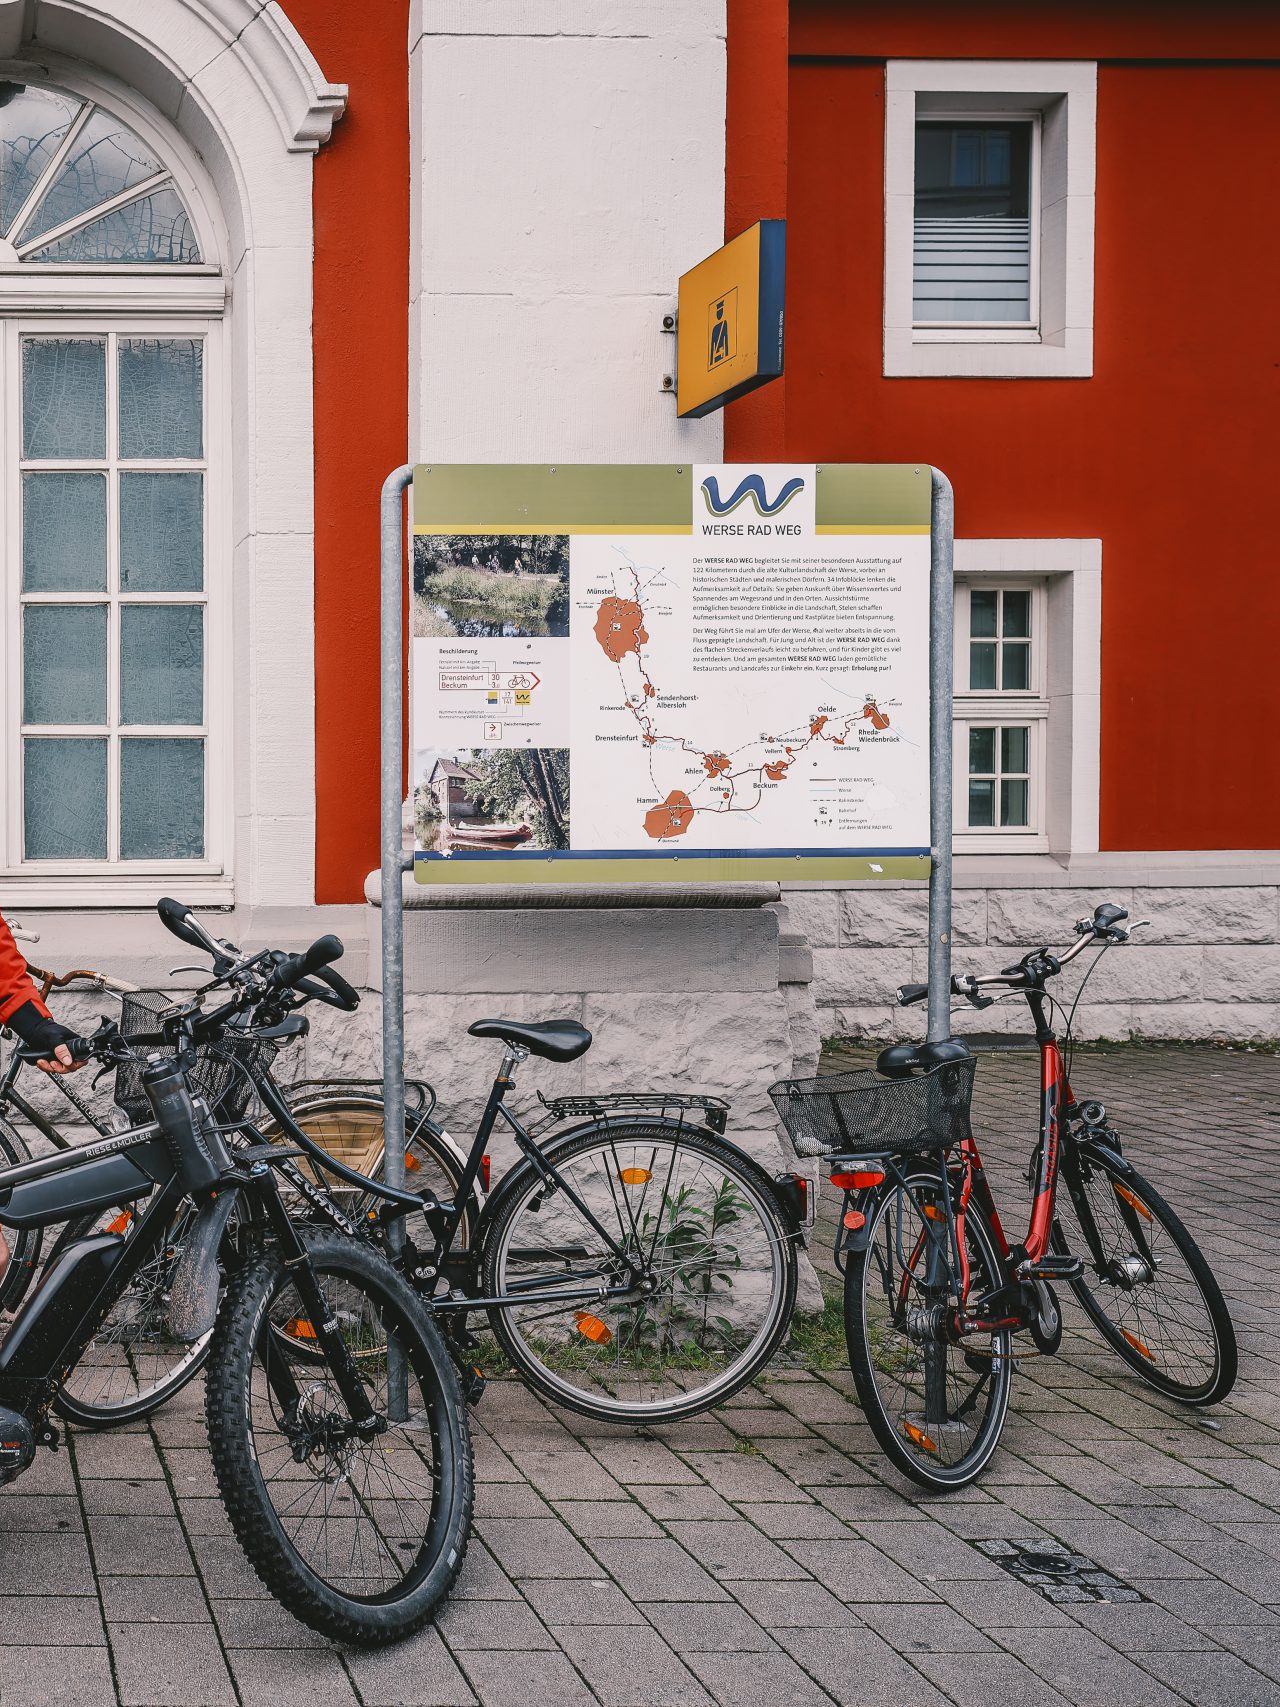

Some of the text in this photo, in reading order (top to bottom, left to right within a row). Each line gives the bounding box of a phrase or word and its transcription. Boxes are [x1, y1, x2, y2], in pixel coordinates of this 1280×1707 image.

[702, 525, 802, 536] WERSE RAD WEG
[282, 1163, 354, 1235] PEGASUS
[455, 1404, 470, 1547] SCHWALBE
